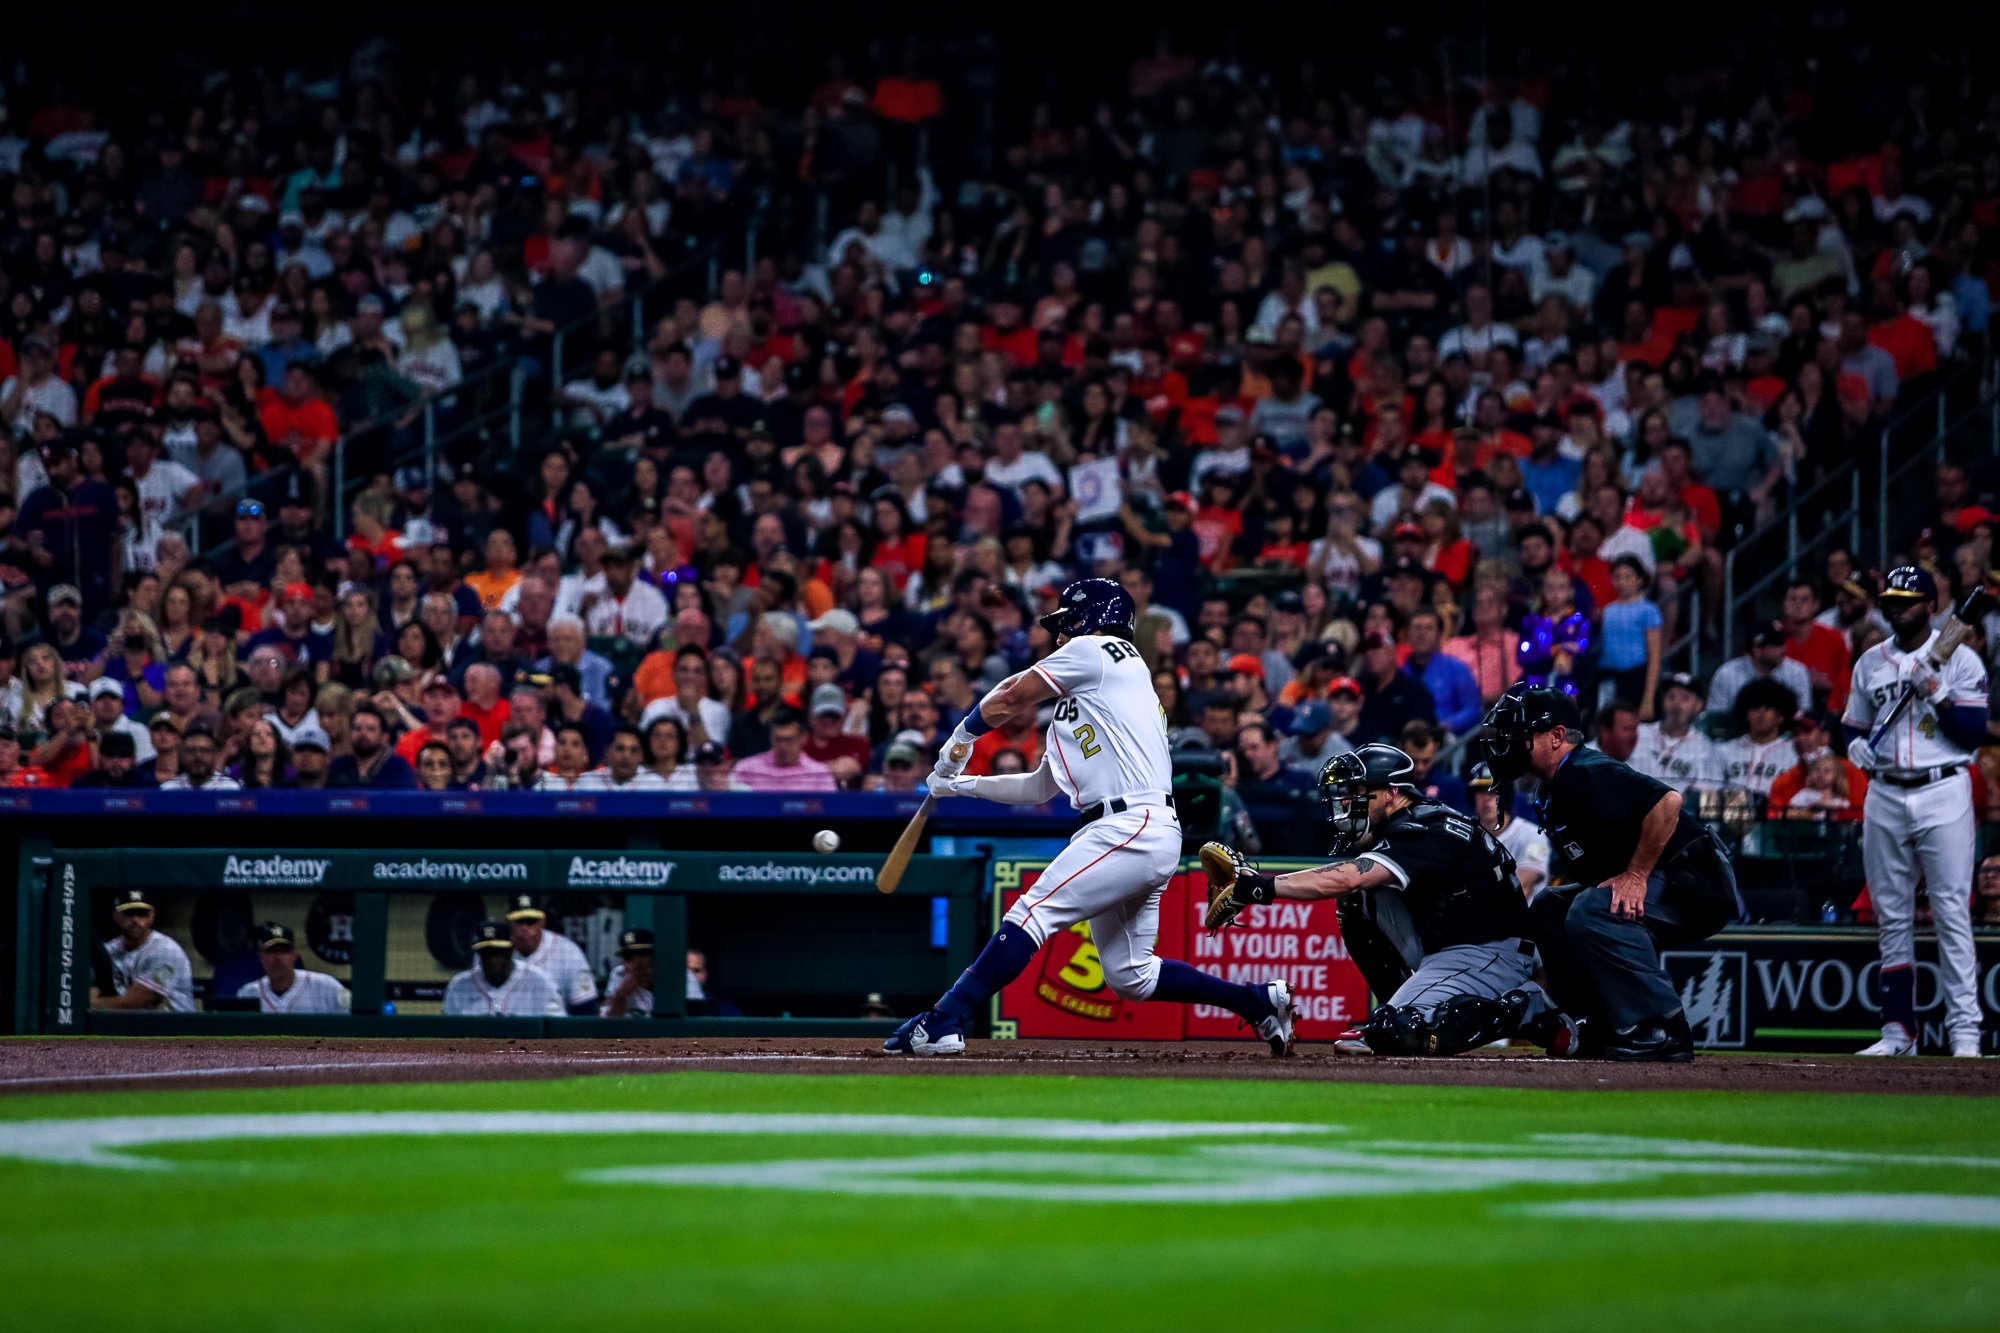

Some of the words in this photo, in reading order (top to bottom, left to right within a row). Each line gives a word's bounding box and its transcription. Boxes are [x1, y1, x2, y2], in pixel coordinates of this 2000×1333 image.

[1073, 723, 1102, 760] 2
[224, 854, 328, 883] Academy
[373, 857, 528, 882] academy.com
[568, 855, 672, 886] Academy
[718, 860, 874, 885] academy.com
[1249, 902, 1314, 930] STAY
[57, 862, 75, 1025] ASTROS.COM
[1195, 932, 1223, 958] IN
[1229, 933, 1300, 959] YOUR
[1057, 941, 1106, 992] 5
[1228, 964, 1329, 991] MINUTE
